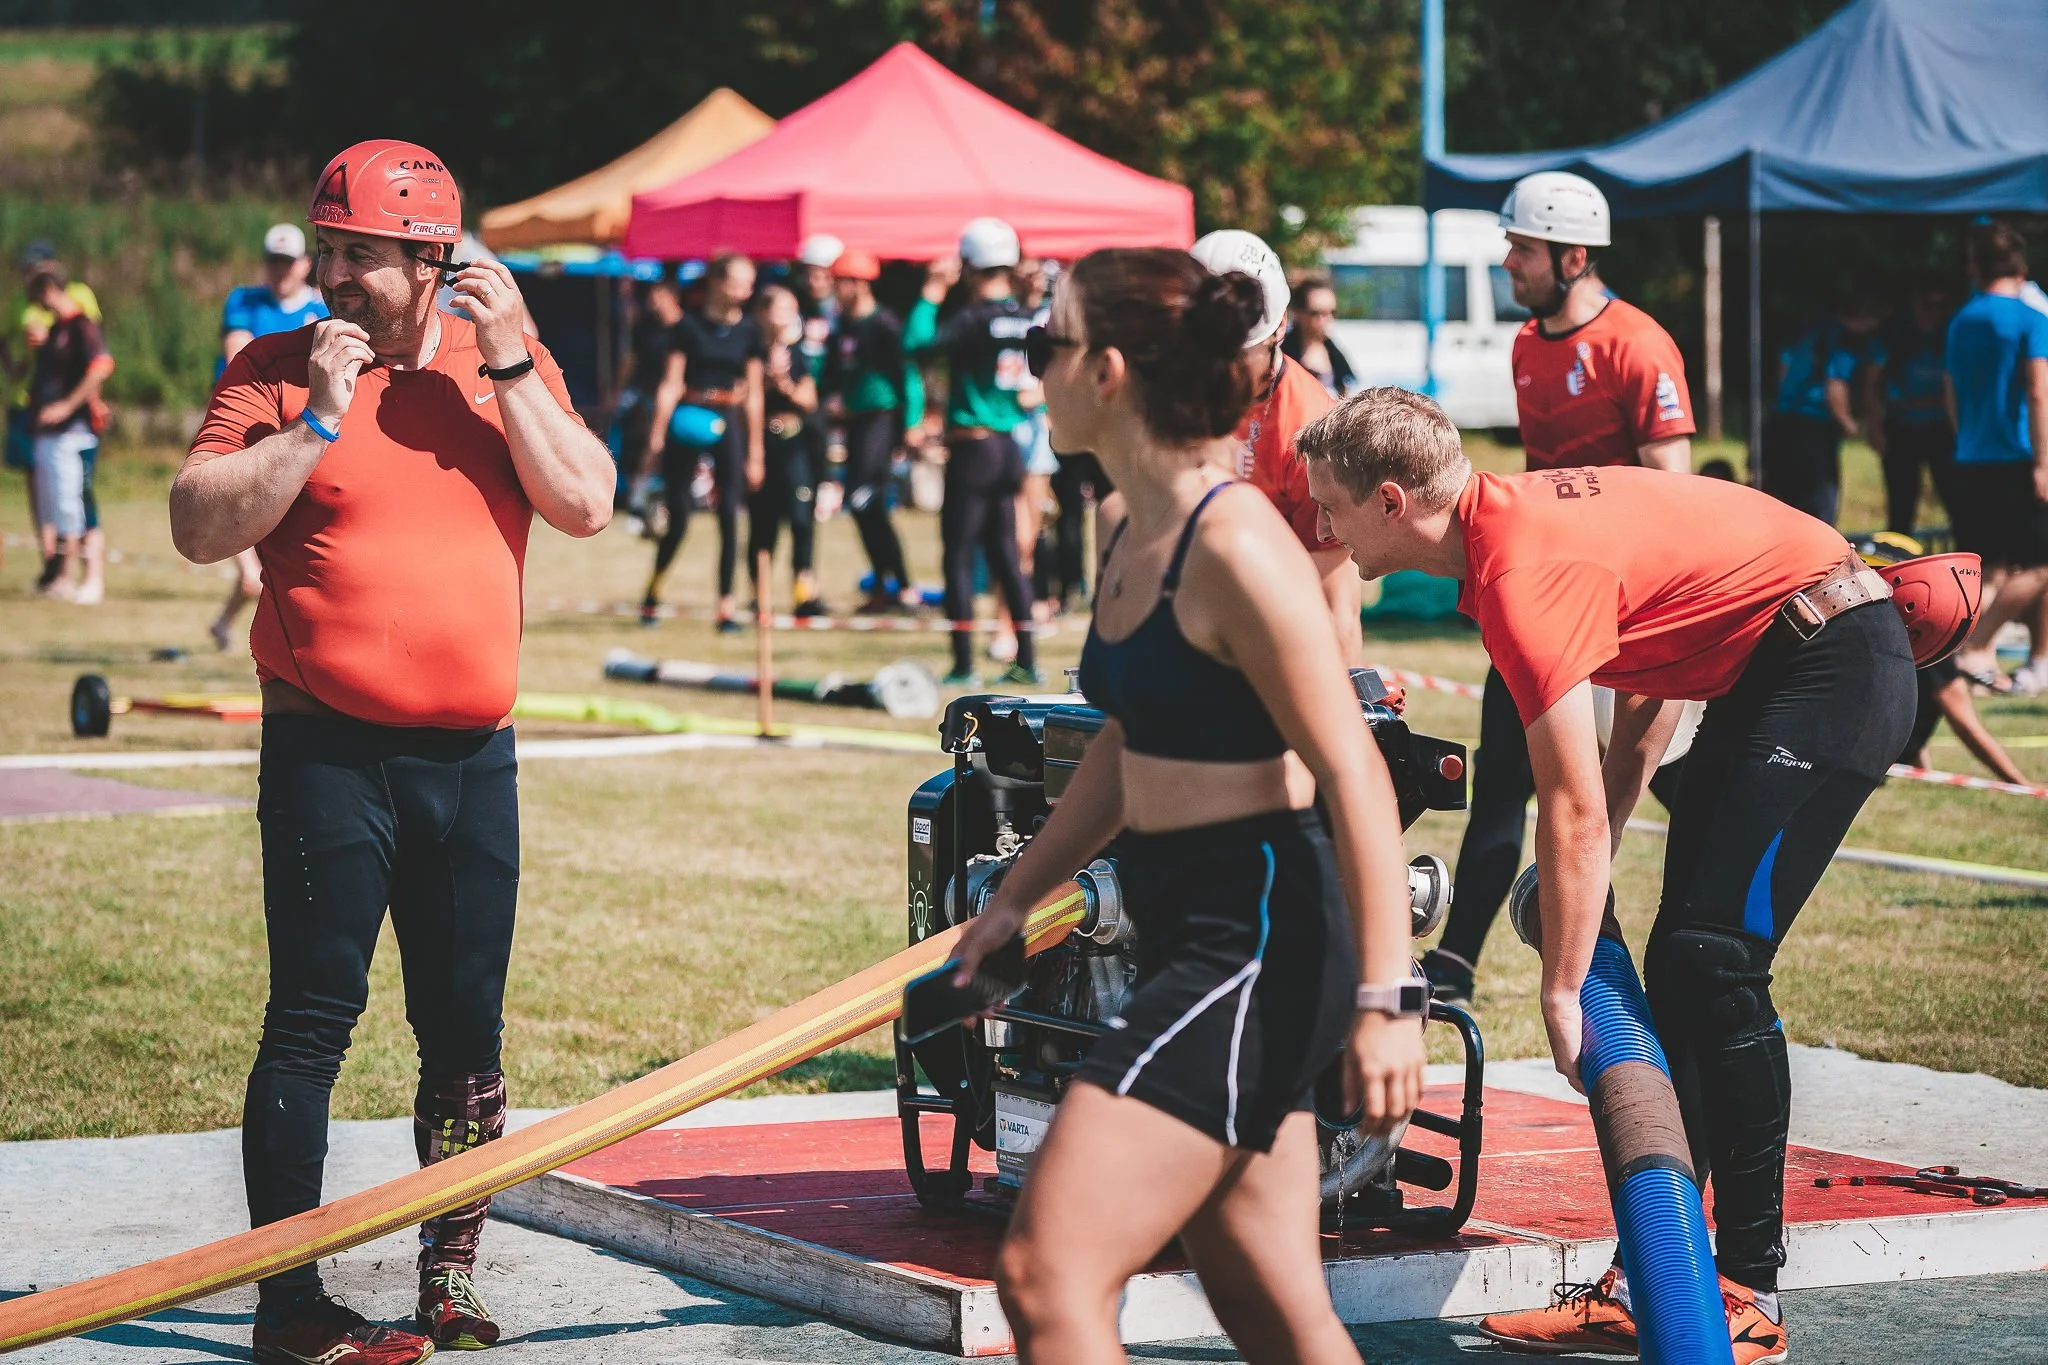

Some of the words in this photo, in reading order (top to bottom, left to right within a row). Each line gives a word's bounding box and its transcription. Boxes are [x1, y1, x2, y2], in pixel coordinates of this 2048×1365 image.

[399, 160, 444, 173] CAMP
[1766, 753, 1813, 770] Rogelli
[1007, 1120, 1030, 1136] VARTA
